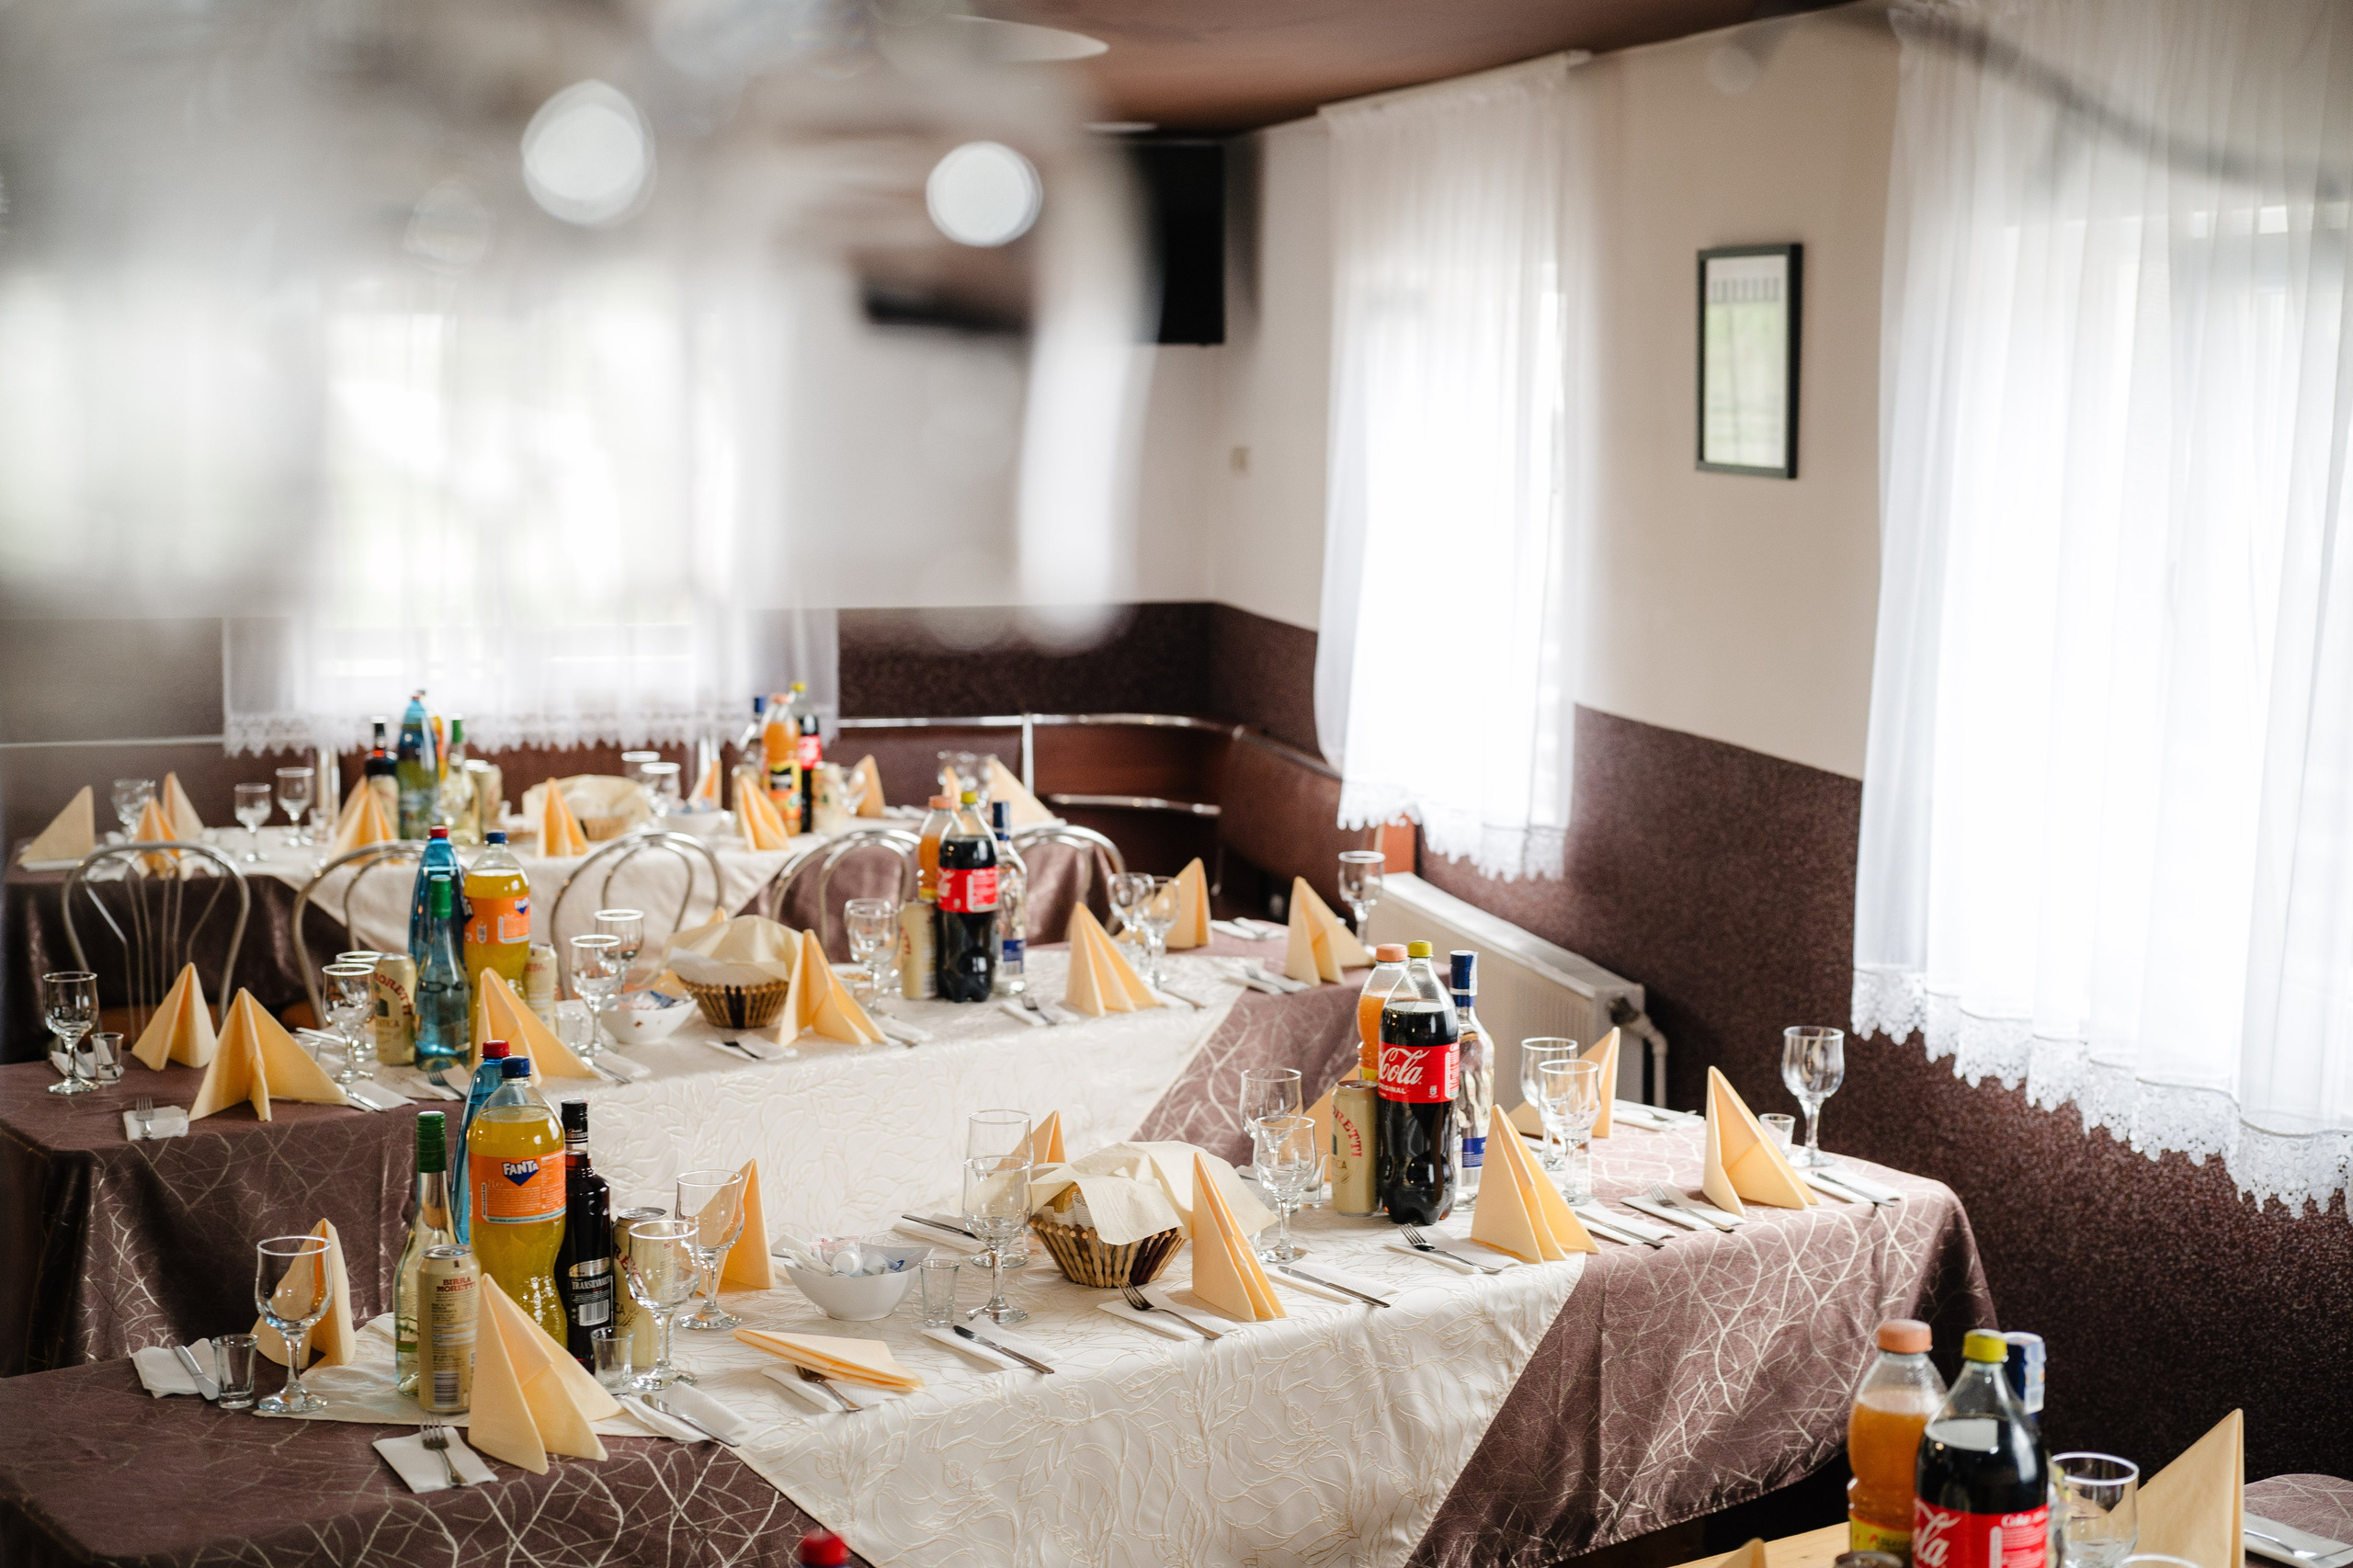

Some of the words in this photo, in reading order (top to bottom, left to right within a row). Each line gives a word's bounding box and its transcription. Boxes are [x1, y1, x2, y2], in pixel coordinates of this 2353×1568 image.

[1380, 1047, 1430, 1085] Cola
[503, 1159, 540, 1176] FANTA
[436, 1281, 476, 1292] MORETTI
[443, 1277, 472, 1286] BIRRA
